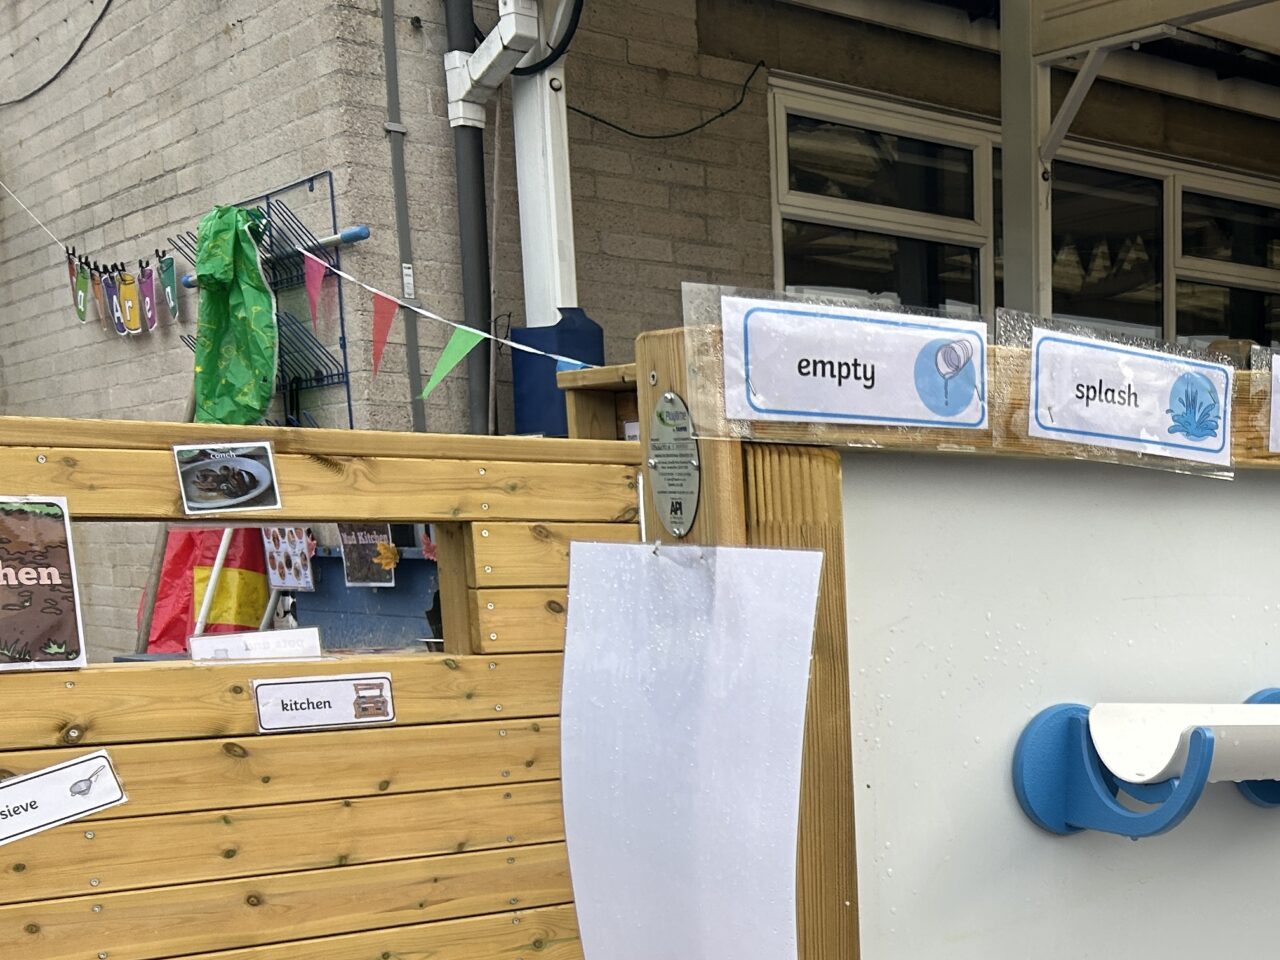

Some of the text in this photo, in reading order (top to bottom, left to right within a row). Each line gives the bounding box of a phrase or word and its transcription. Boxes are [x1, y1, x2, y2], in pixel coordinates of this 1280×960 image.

[797, 358, 875, 389] empty
[1075, 379, 1139, 408] splash
[210, 451, 236, 459] conch
[670, 501, 683, 515] API
[357, 530, 388, 545] Kitchen
[281, 698, 332, 712] kitchen
[0, 800, 39, 820] sieve
